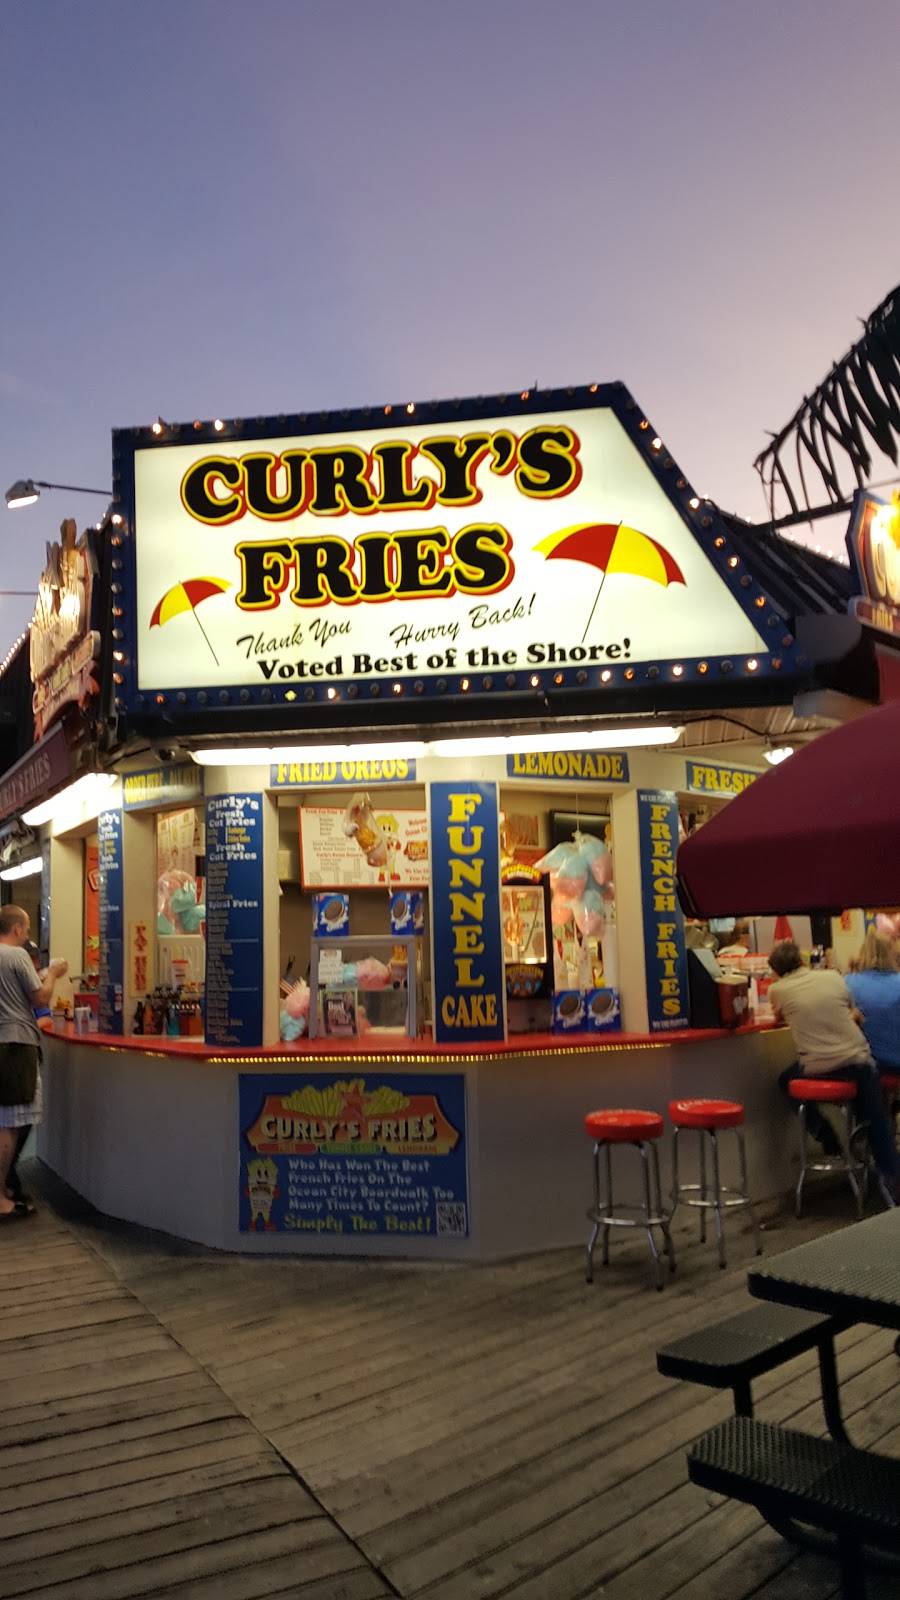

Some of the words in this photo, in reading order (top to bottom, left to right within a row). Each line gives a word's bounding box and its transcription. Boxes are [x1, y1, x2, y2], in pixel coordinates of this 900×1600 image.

[180, 424, 582, 526] CURLY'S
[234, 521, 516, 612] FRIES
[236, 623, 304, 659] Thank
[308, 617, 352, 648] You
[389, 621, 460, 649] Hurry
[468, 592, 536, 629] Back!
[257, 655, 344, 680] Voted
[352, 652, 418, 674] Best
[426, 649, 457, 669] of
[467, 646, 517, 667] the
[526, 637, 631, 664] Shore!
[277, 760, 338, 783] FRIED
[341, 758, 409, 781] OREOS
[513, 751, 624, 779] LEMONADE
[207, 796, 260, 812] Curly's
[226, 817, 256, 827] Fries
[227, 852, 257, 861] Fries
[650, 803, 677, 913] FRENCH
[447, 793, 486, 987] FUNNEL
[655, 922, 681, 1016] FRIES
[441, 993, 498, 1028] CAKE
[260, 1115, 361, 1140] CURLY'S
[368, 1113, 438, 1142] FRIES
[288, 1159, 315, 1169] Who
